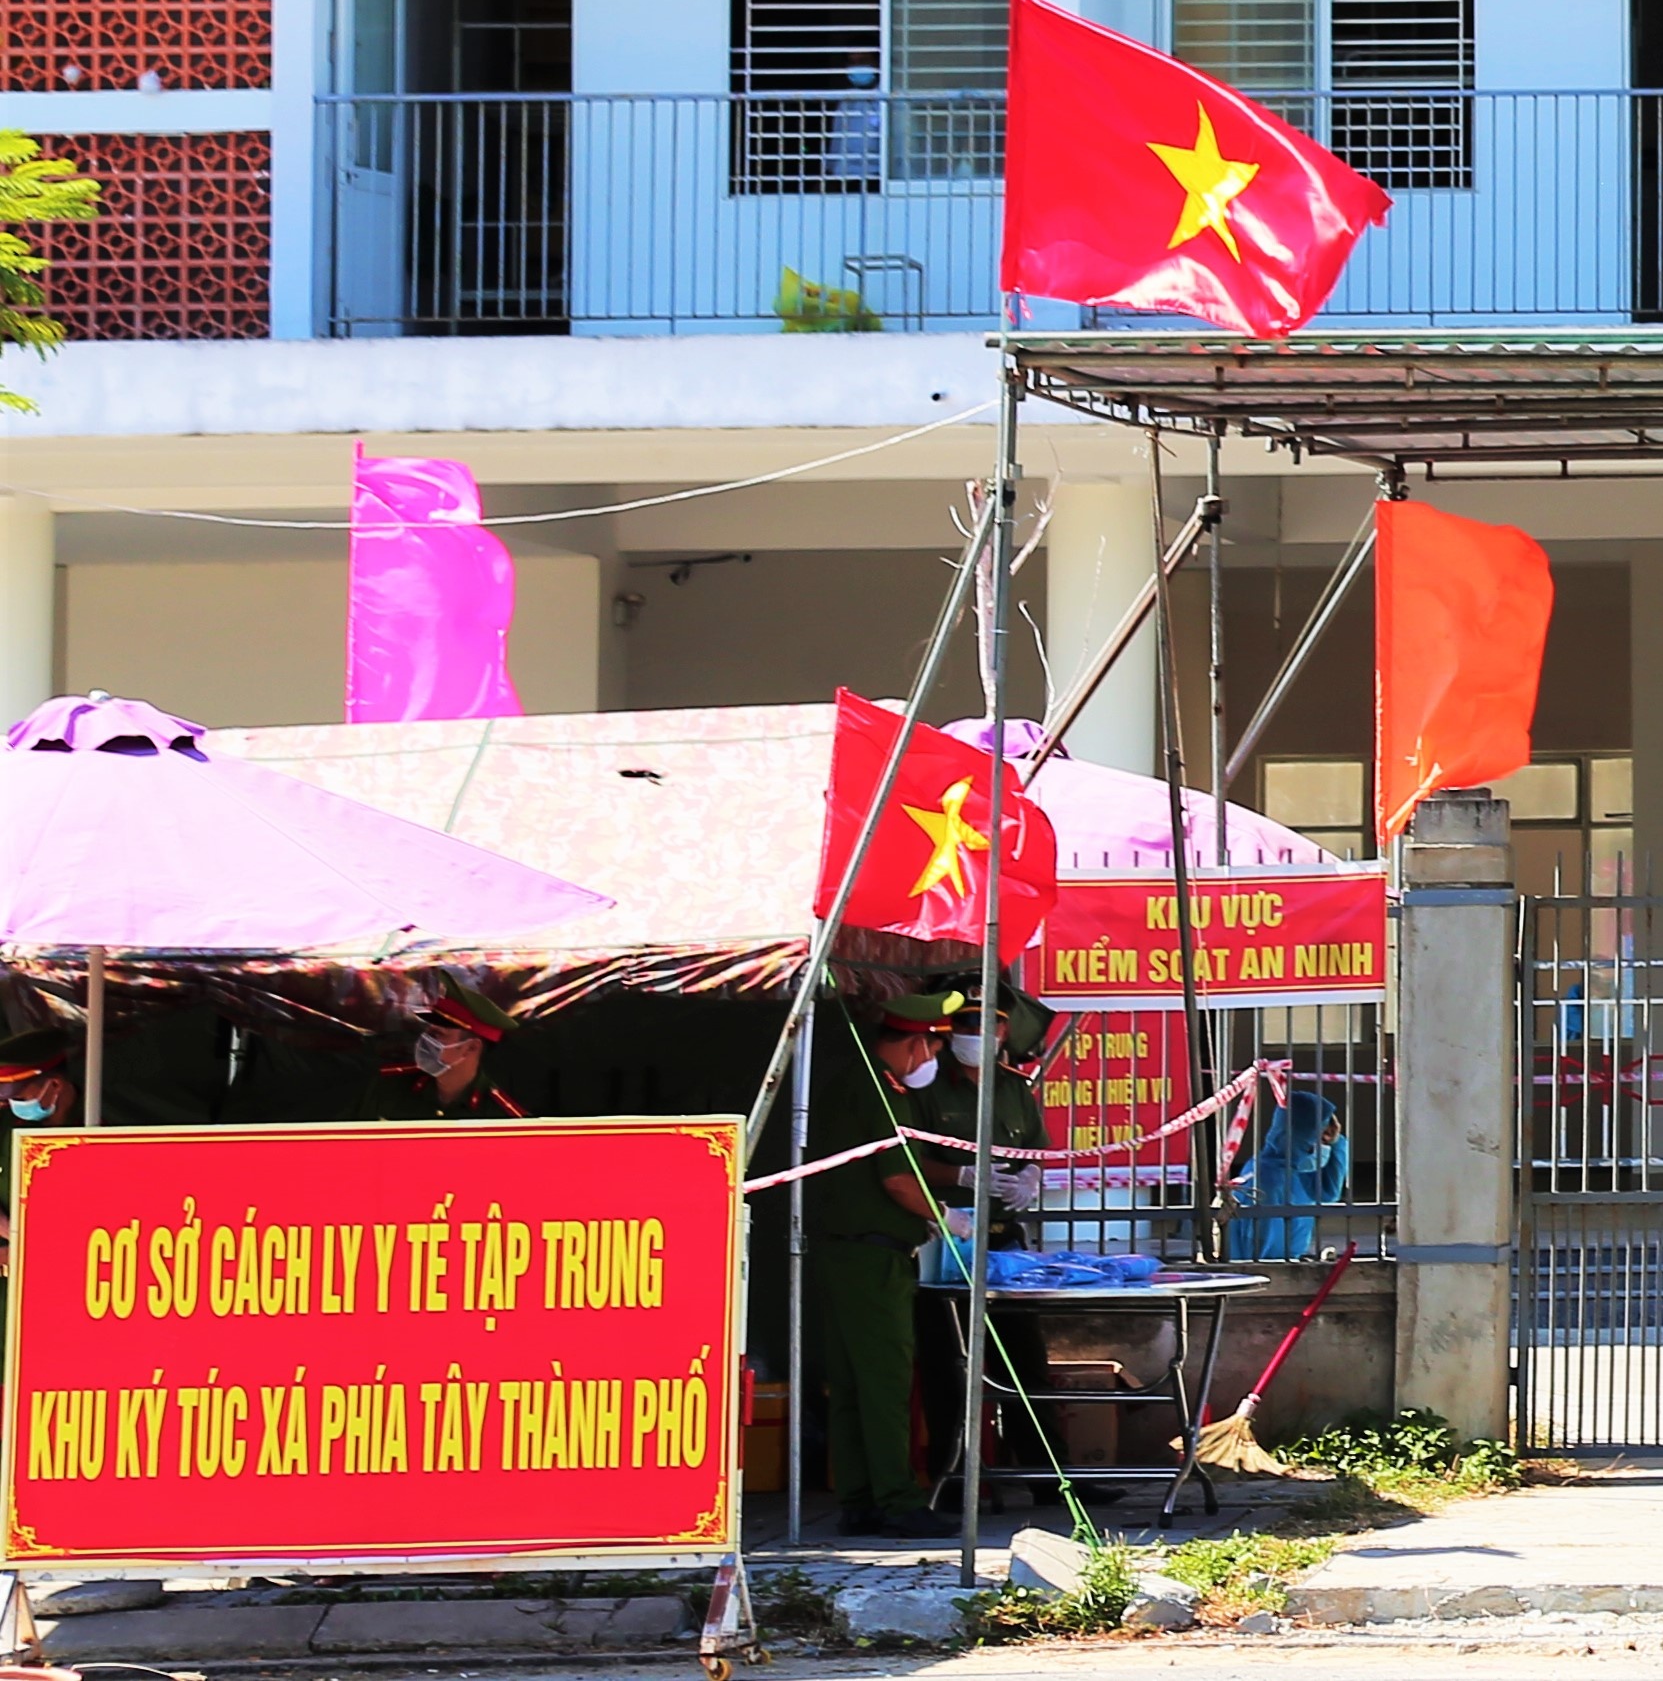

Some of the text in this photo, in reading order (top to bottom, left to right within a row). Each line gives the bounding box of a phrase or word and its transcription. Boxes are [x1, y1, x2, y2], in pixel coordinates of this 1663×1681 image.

[1220, 890, 1283, 935] VỰC
[1056, 935, 1138, 983] KIỂM
[1239, 945, 1285, 980] AN
[1294, 942, 1373, 978] NINH
[85, 1193, 664, 1331] CƠ SỞ CÁCH LY Y TẾ TẬP TRUNG
[28, 1344, 711, 1480] KHU KÝ TÚC XÁ PHÍA TÂY THÀNH PHỐ
